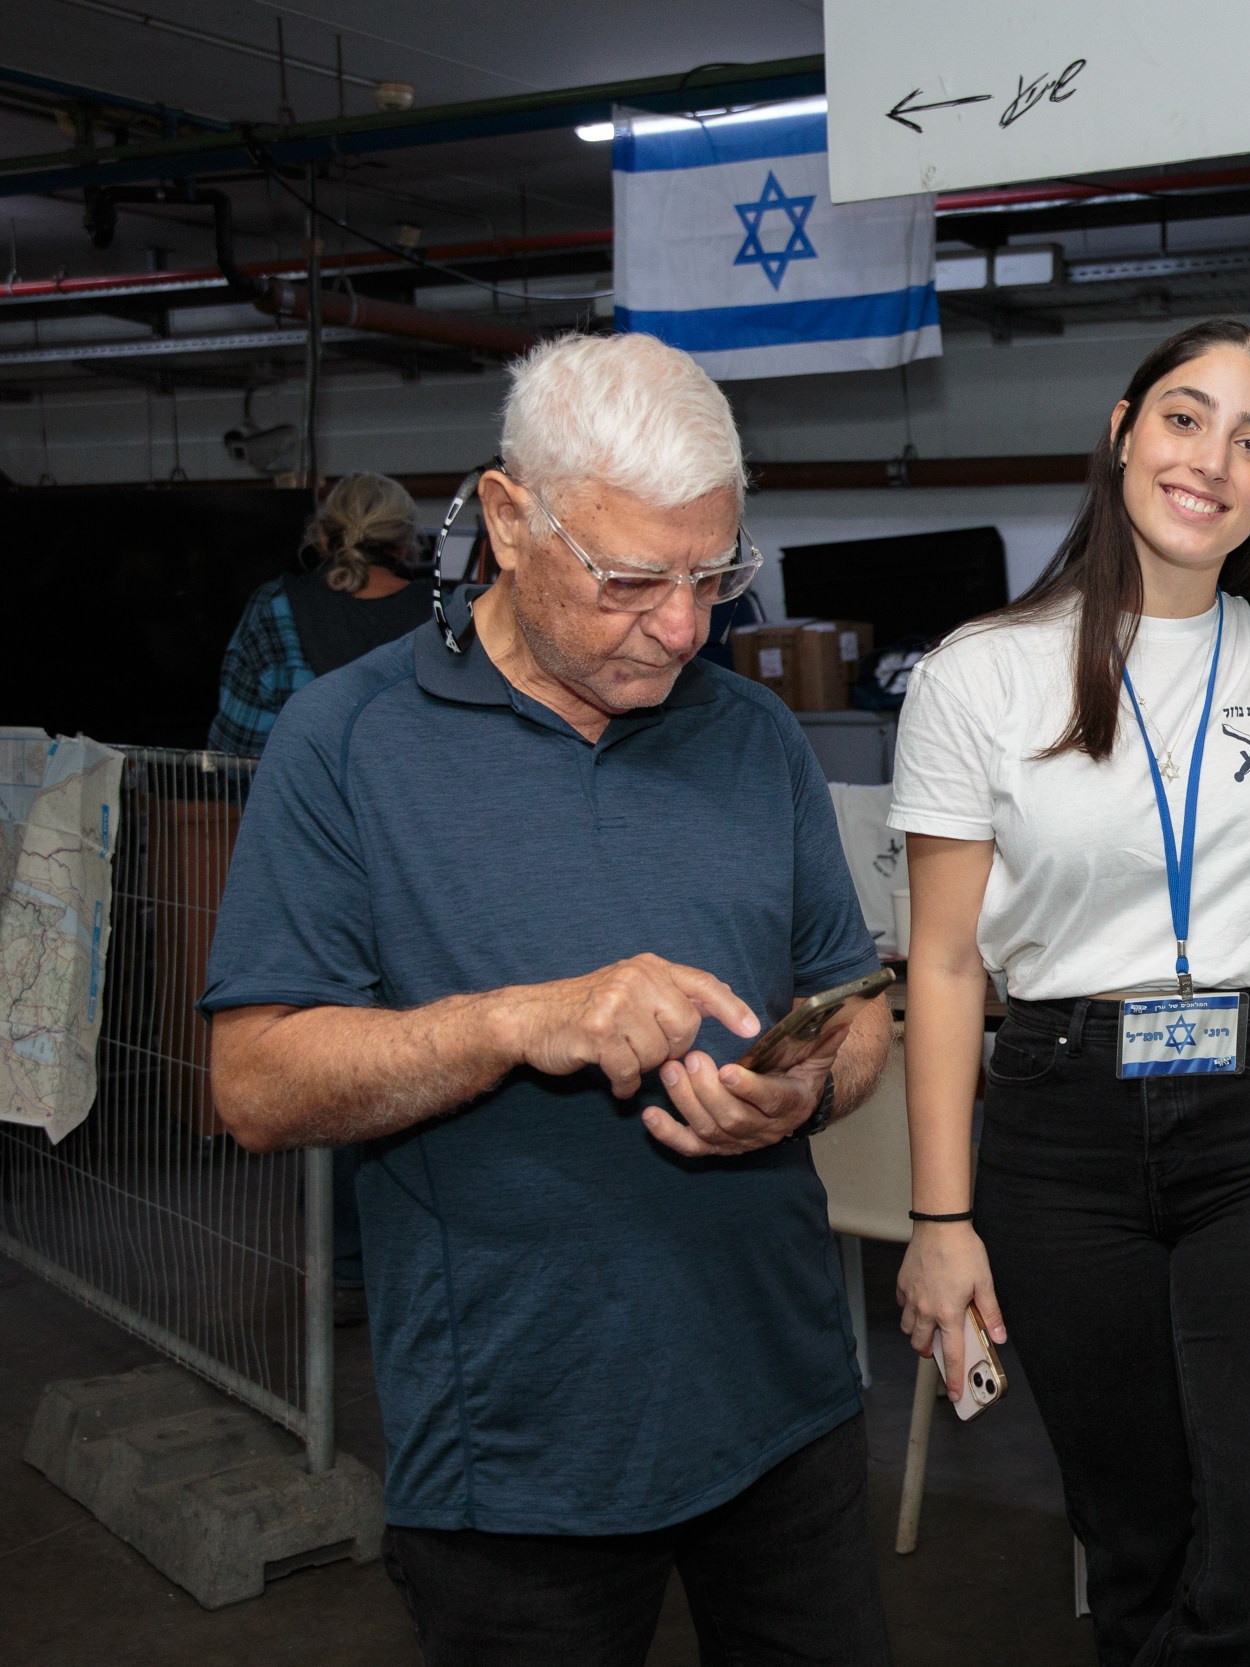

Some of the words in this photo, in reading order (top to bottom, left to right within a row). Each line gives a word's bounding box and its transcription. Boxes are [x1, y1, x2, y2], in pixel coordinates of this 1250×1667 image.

[1223, 706, 1244, 718] ברזל
[1126, 1030, 1164, 1043] חמ"ל
[1204, 1028, 1230, 1037] רוני
